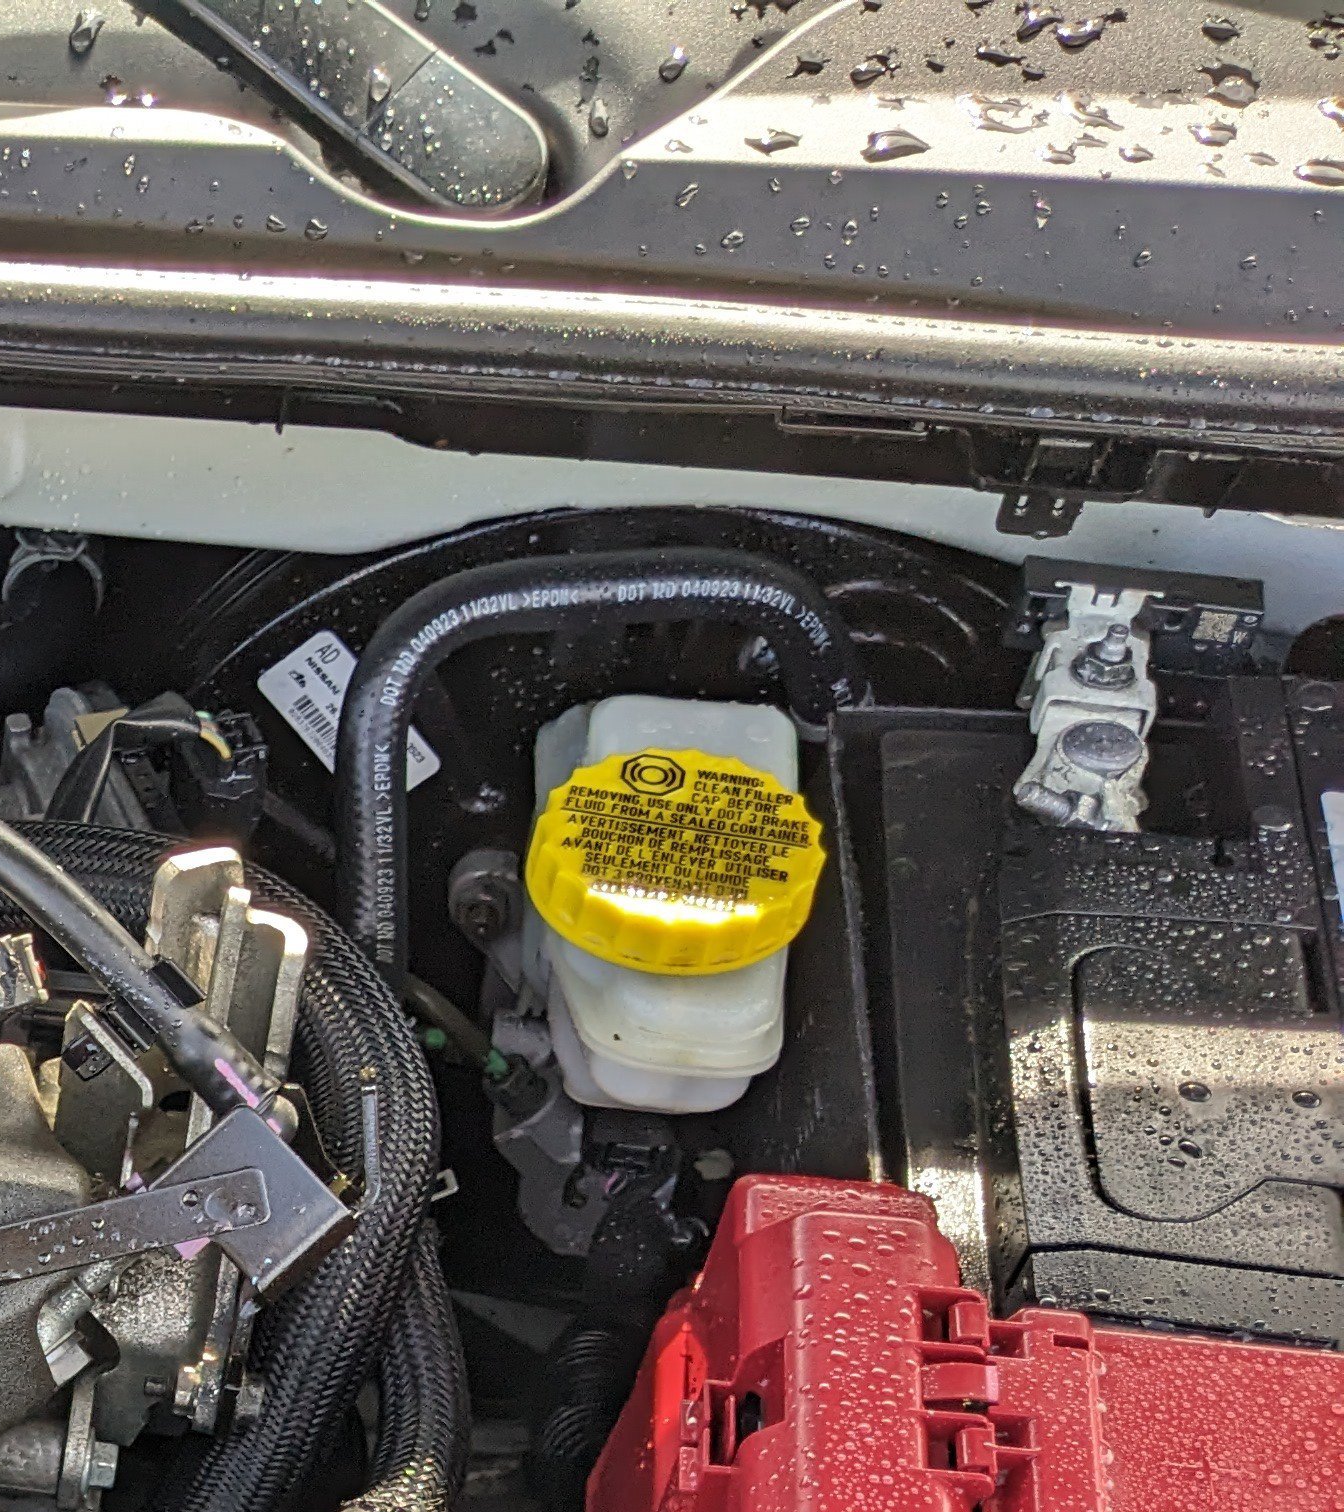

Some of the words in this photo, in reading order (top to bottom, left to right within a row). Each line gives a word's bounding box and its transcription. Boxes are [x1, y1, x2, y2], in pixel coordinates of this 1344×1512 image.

[616, 581, 647, 602] DOT
[315, 643, 340, 664] AD
[305, 656, 340, 695] NISSAN
[379, 677, 403, 707] DOT
[697, 769, 764, 787] WARNING:
[691, 792, 720, 805] CAP
[727, 797, 781, 816] BEFORE
[693, 781, 741, 797] CLEAN
[744, 788, 793, 805] FILLER
[565, 796, 605, 812] FLUID
[611, 803, 650, 819] FROM
[655, 811, 664, 821] A
[670, 813, 726, 830] SEALED
[647, 797, 673, 810] USE
[676, 802, 713, 816] ONLY
[717, 808, 743, 820] DOT
[749, 813, 757, 823] 3
[761, 814, 810, 832] BRAKE
[581, 827, 645, 846] BOUCHON
[648, 838, 666, 850] DE
[693, 833, 768, 854] NETTOYER
[772, 845, 790, 858] LE
[561, 836, 612, 853] AVANT
[615, 844, 633, 856] DE
[725, 861, 788, 883] UTILISER
[584, 851, 668, 874] SEULEMENT
[673, 865, 691, 878] DU
[695, 869, 750, 888] LIQUIDE
